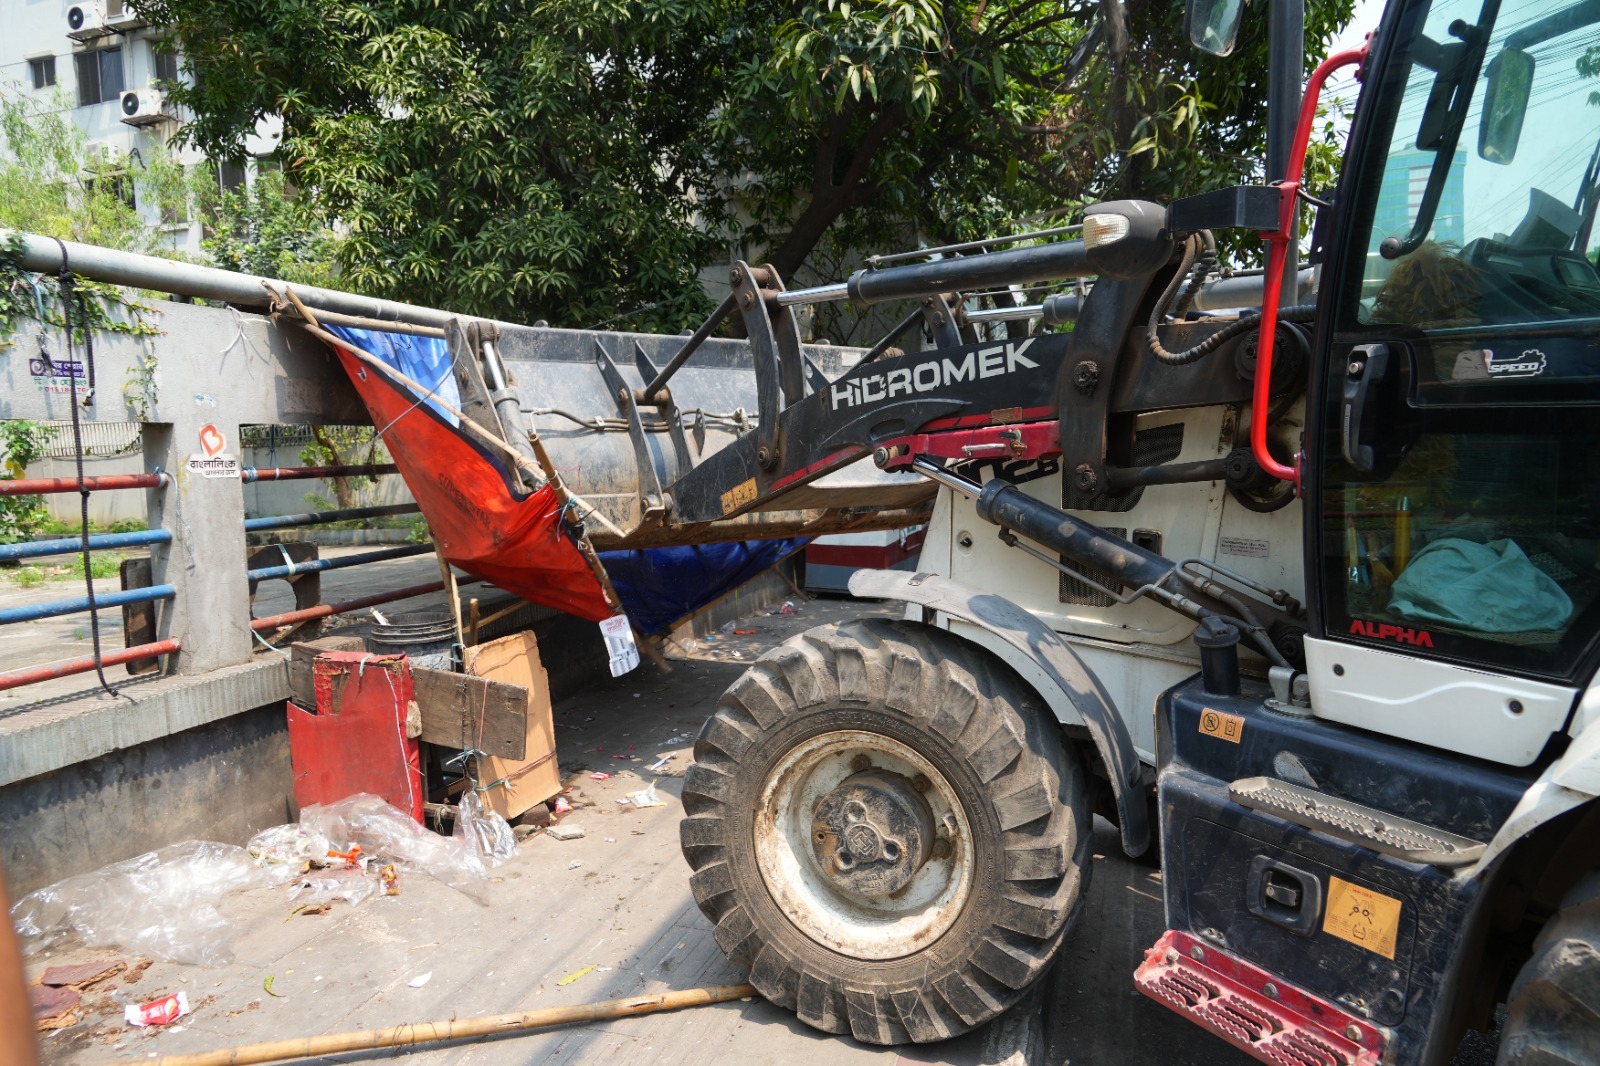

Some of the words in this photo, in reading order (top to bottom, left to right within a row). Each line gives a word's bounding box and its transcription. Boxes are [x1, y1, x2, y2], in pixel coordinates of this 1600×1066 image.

[1489, 362, 1540, 373] SPEED
[190, 457, 236, 469] বাংলালিংক
[1349, 619, 1435, 648] ALPHA
